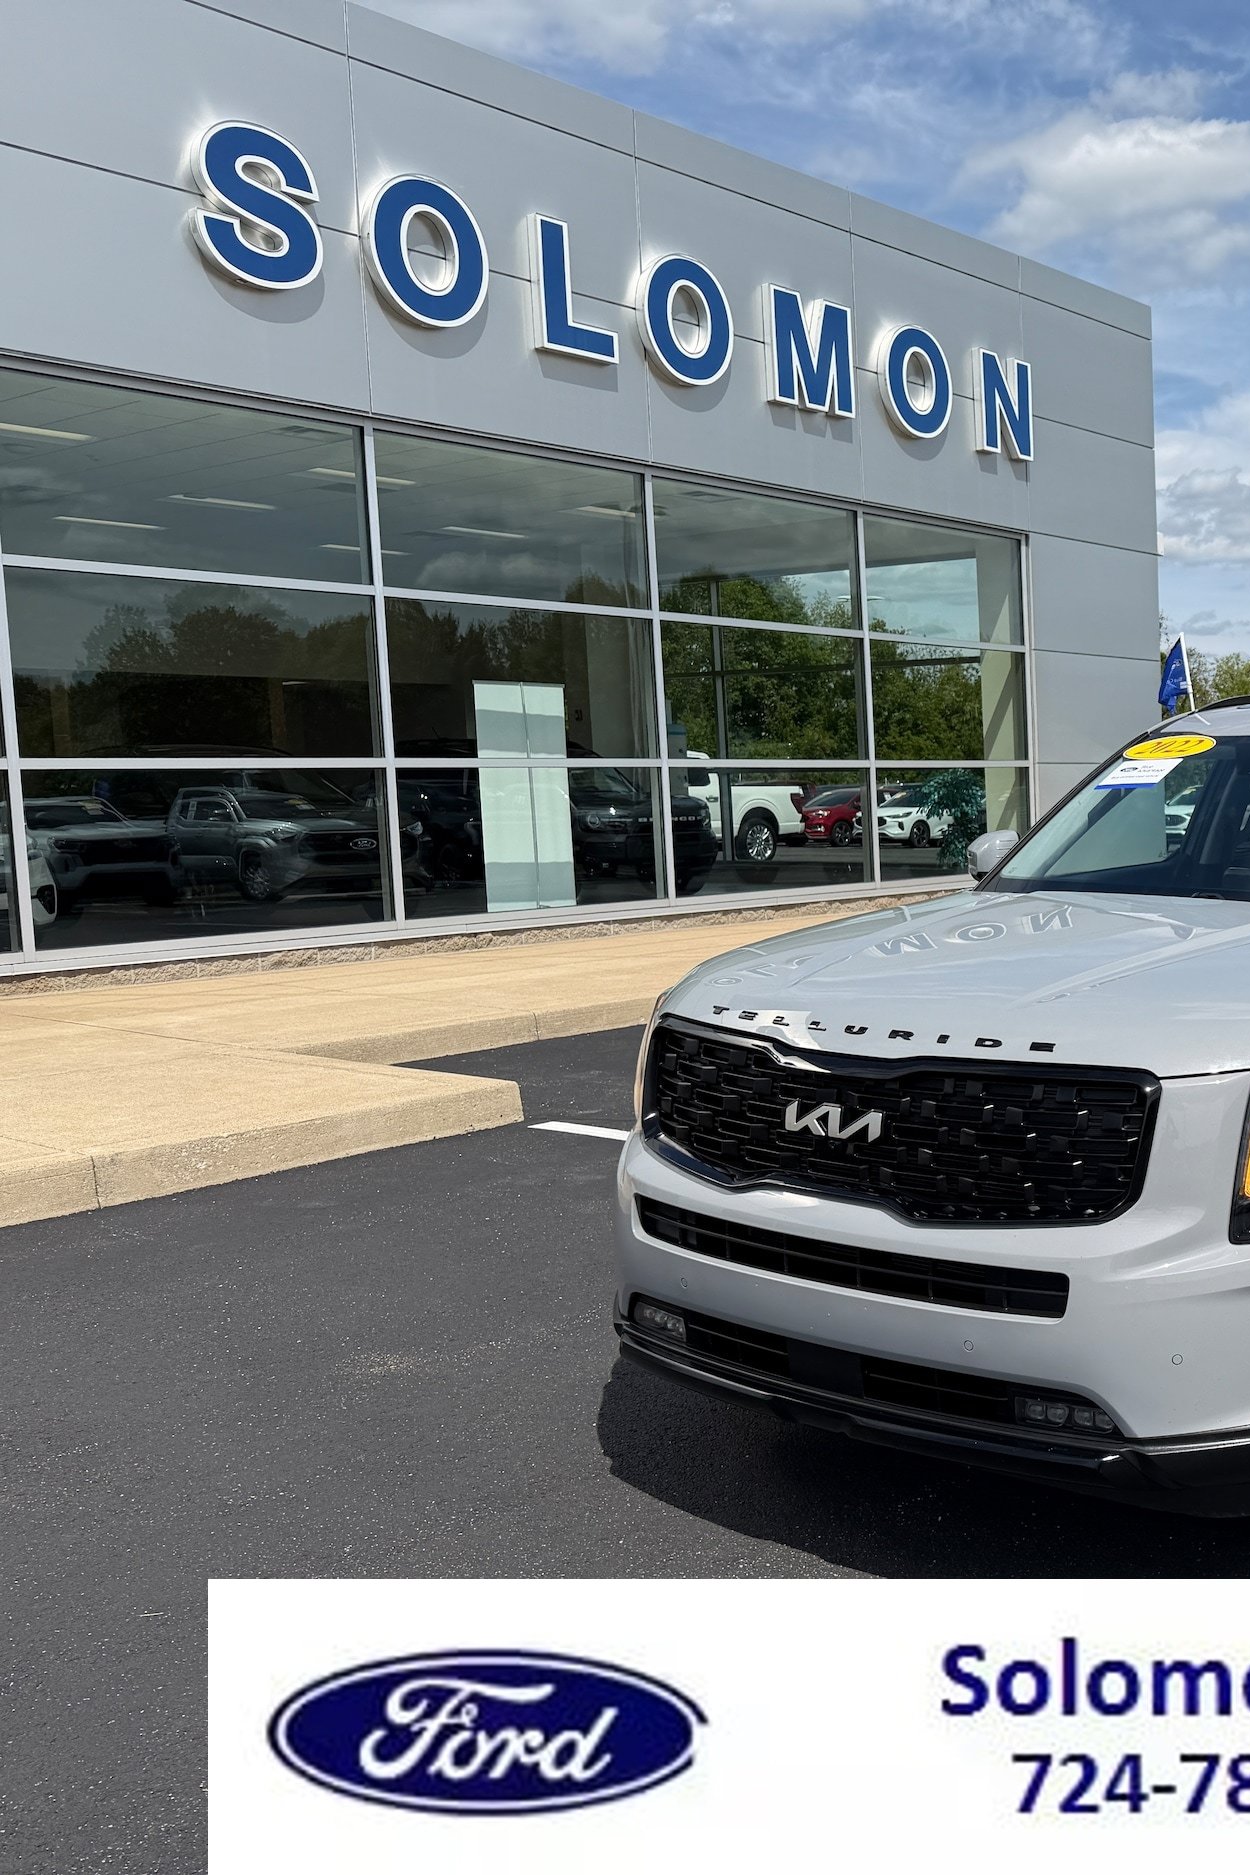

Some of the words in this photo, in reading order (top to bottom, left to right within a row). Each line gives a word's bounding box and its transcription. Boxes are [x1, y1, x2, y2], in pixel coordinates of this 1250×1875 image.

[190, 119, 1034, 463] SOLOMON
[1134, 739, 1205, 756] 2022
[713, 1005, 1056, 1053] TELLURIDE
[784, 1098, 884, 1144] KIA
